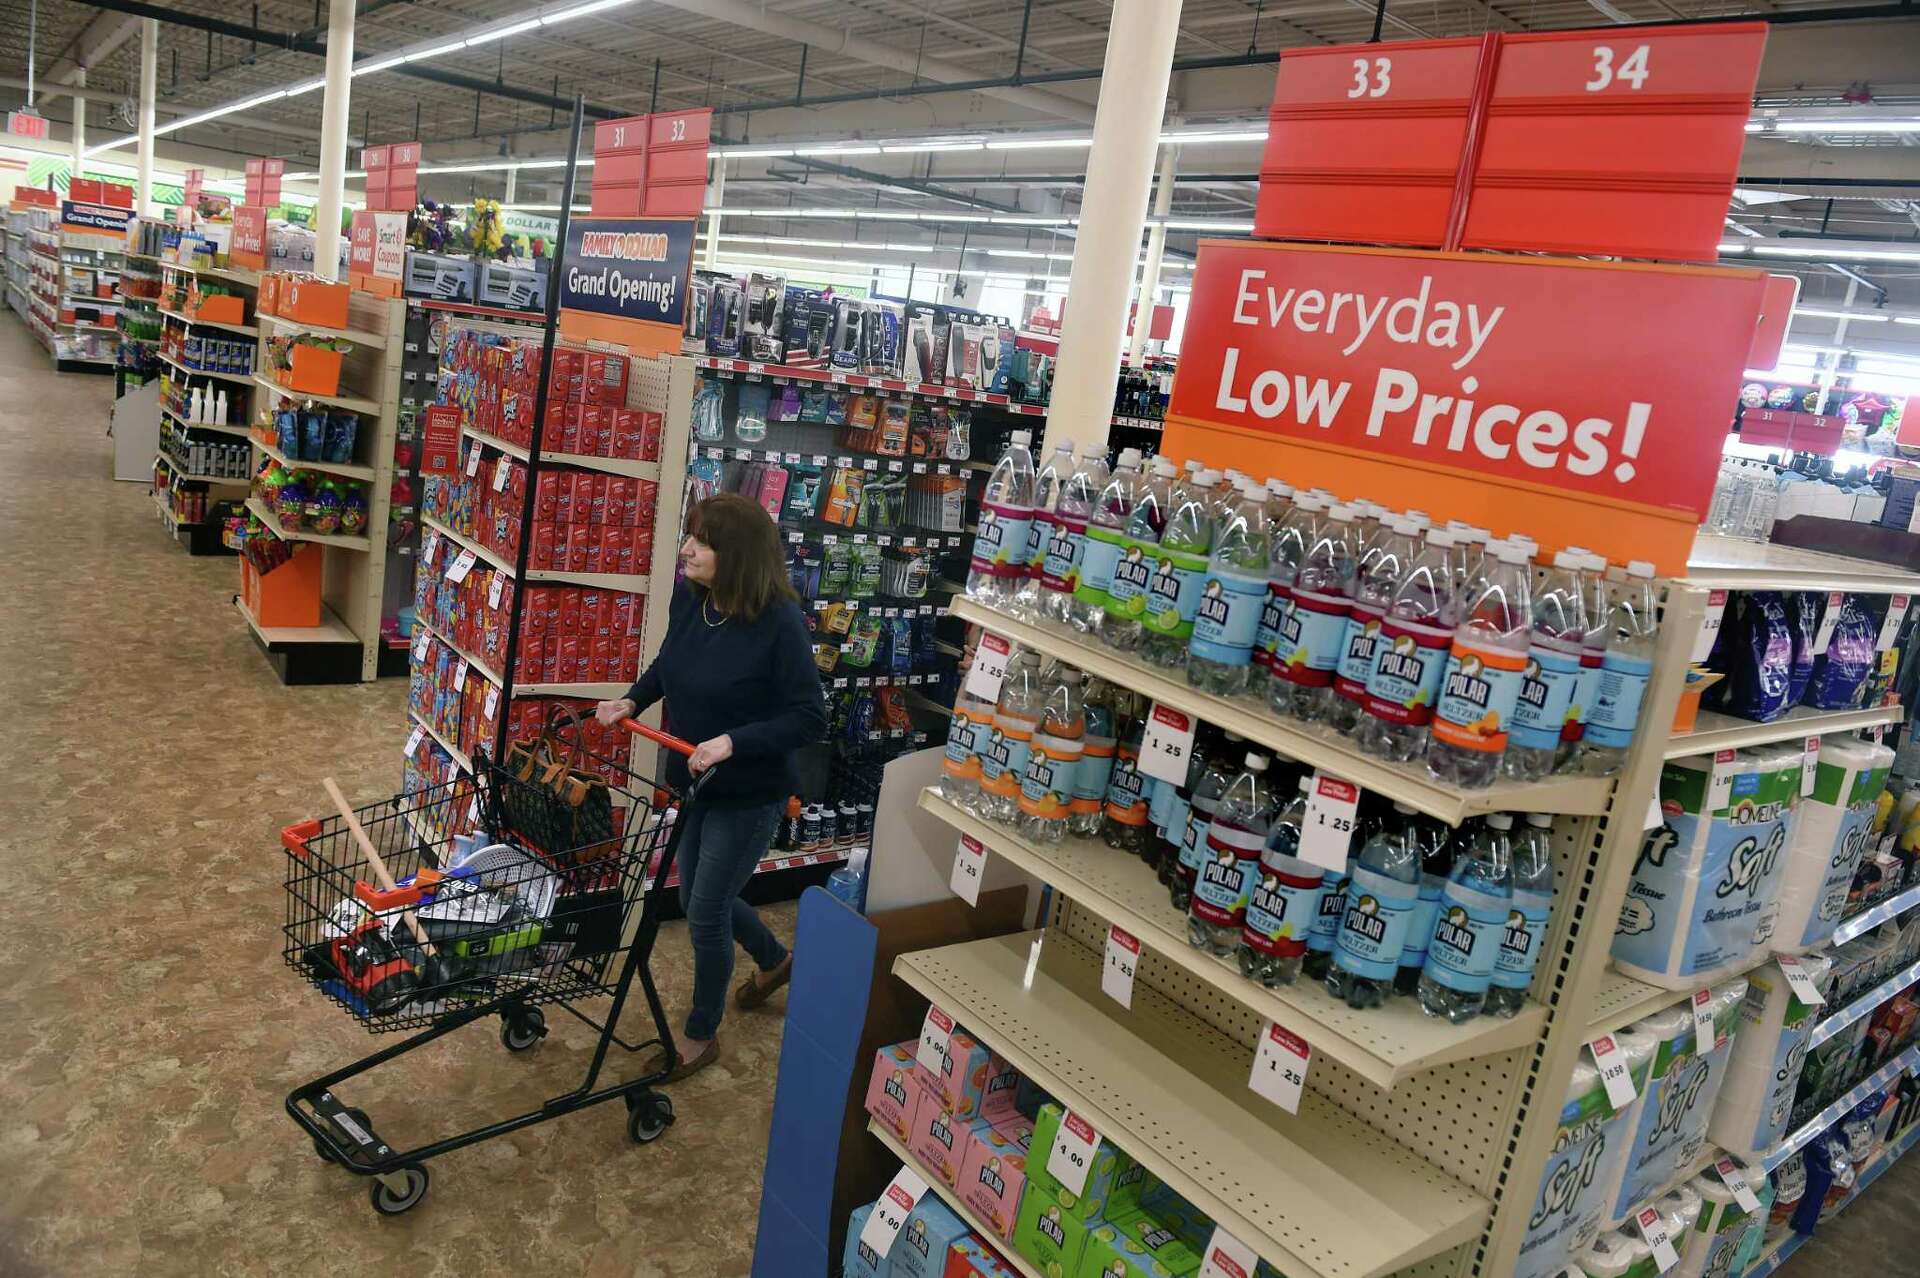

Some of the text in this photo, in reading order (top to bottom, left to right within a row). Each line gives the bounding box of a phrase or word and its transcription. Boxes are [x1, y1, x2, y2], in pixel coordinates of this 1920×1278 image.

[1347, 57, 1391, 98] 33
[1586, 46, 1650, 92] 34
[16, 112, 46, 138] EXIT
[614, 127, 625, 147] 31
[671, 120, 686, 141] 32
[66, 212, 94, 223] Grand
[95, 215, 128, 228] Openin
[506, 216, 552, 231] DOLLAR
[357, 226, 371, 242] SAVE
[581, 232, 668, 262] FAMILY DOLLAR
[568, 266, 676, 313] Grand Opening!
[1232, 269, 1505, 371] Everyday
[833, 354, 858, 364] BEARD
[1215, 347, 1653, 485] Low Prices!
[1762, 411, 1774, 421] 31
[1814, 417, 1827, 427] 32
[1116, 561, 1147, 585] POLAR
[1200, 597, 1226, 622] OLAR
[1284, 617, 1299, 641] LAR
[1351, 638, 1373, 659] POL
[1379, 653, 1421, 682] POLAR
[1447, 674, 1488, 704] POLAR
[1519, 678, 1545, 705] LAR
[988, 741, 1007, 764] OLAR
[1112, 771, 1141, 793] POLAR
[1730, 800, 1783, 826] HOMELINE
[1715, 820, 1787, 899] Soft
[1206, 863, 1241, 890] POLAR
[1252, 887, 1284, 917] POLAR
[1632, 881, 1666, 900] Tissue
[1323, 896, 1344, 913] POL
[1346, 909, 1383, 940] POLAR
[1437, 921, 1472, 951] POLAR
[1503, 927, 1530, 952] OLAR
[886, 1079, 906, 1104] POLAR
[1647, 1060, 1709, 1146] Soft
[932, 1121, 953, 1148] POLAR
[1551, 1117, 1601, 1154] OMELINE
[981, 1167, 1004, 1196] POLAR
[1528, 1133, 1606, 1231] Soft
[907, 1227, 929, 1256] POLAR
[1039, 1216, 1064, 1247] POLAR
